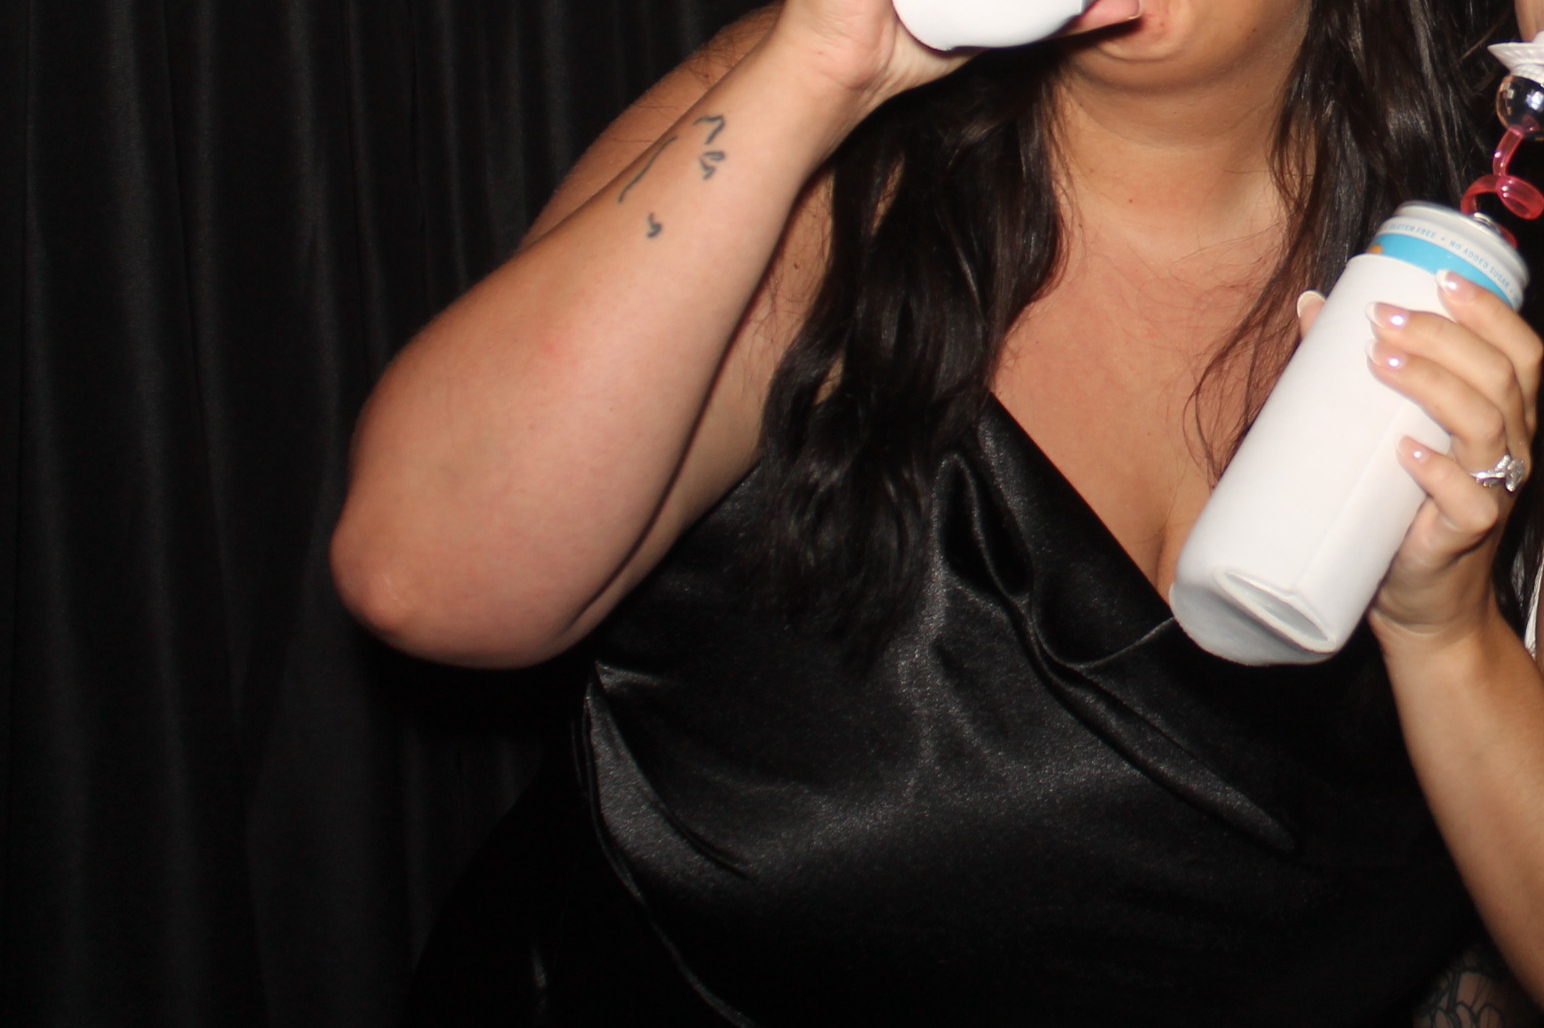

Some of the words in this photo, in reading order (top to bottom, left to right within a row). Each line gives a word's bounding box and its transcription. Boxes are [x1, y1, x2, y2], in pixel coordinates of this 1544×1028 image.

[1449, 240, 1461, 250] NO
[1463, 248, 1488, 269] ADDED
[1489, 267, 1510, 288] SUGAR
